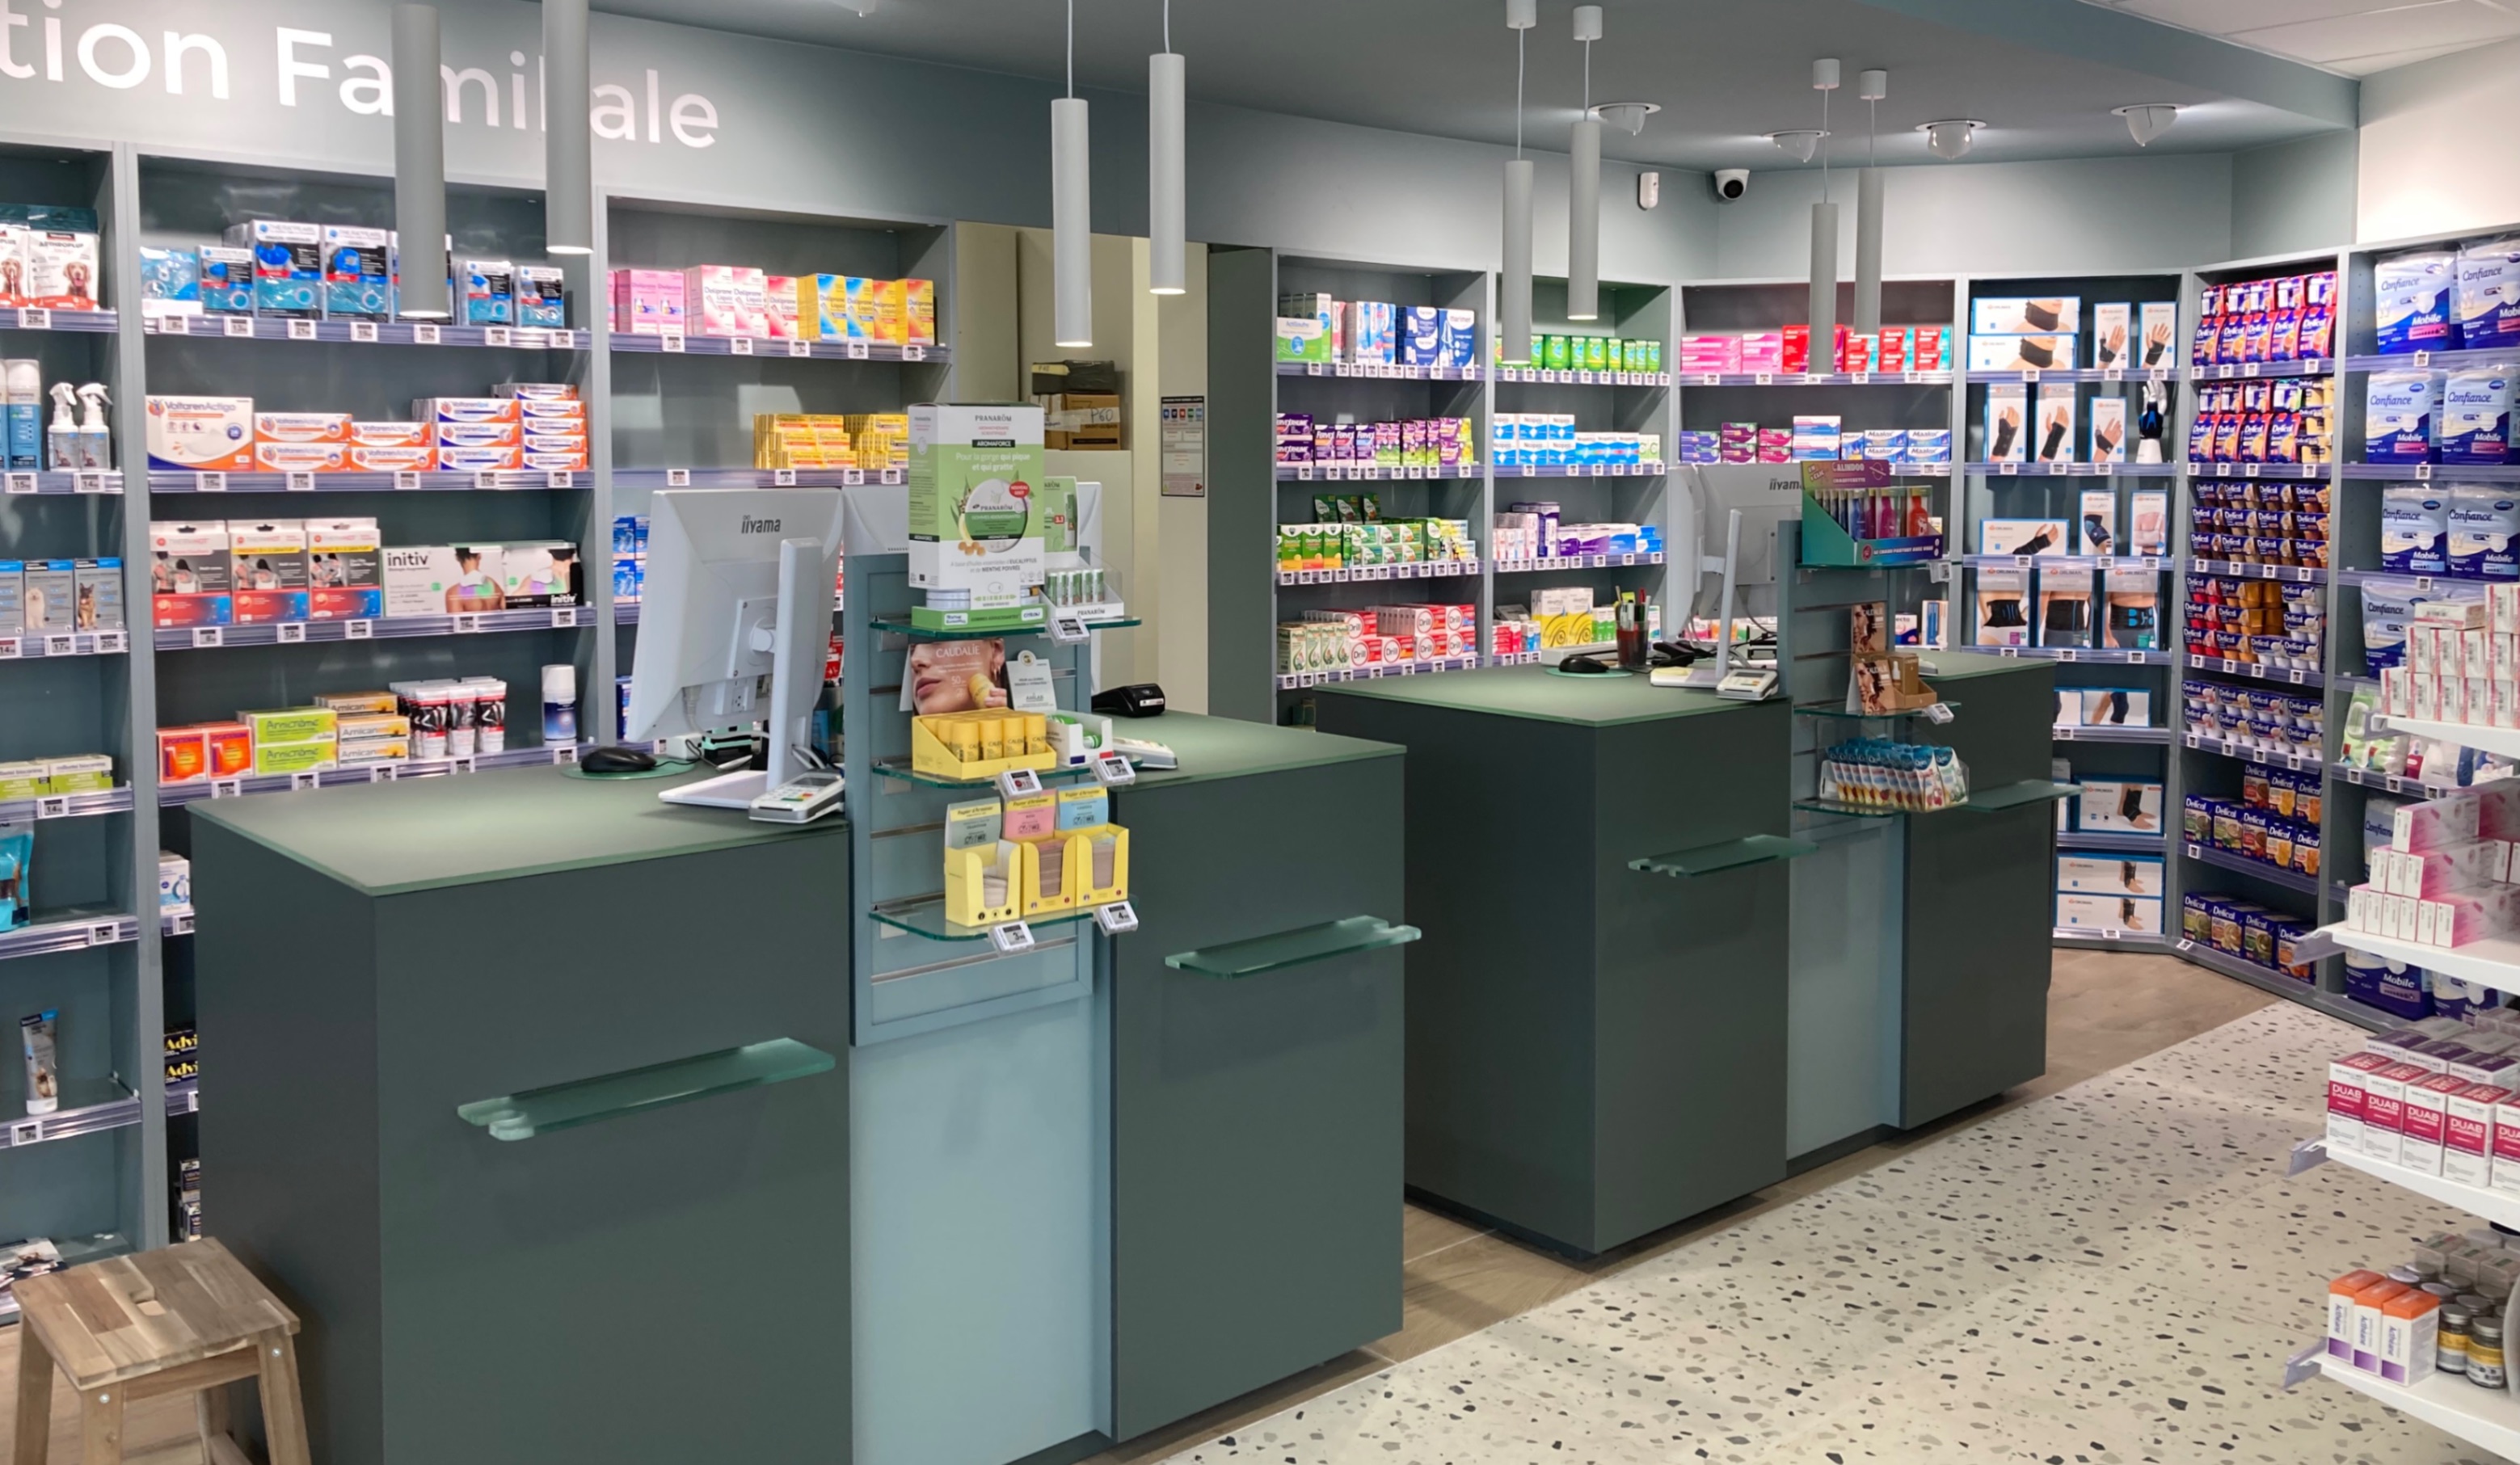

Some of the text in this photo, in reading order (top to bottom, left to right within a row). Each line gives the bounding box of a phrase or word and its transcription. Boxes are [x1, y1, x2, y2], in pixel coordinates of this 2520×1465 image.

[277, 27, 718, 149] Familale
[2463, 267, 2502, 282] Confiance
[2500, 306, 2520, 318] Mobi
[2412, 314, 2442, 325] Mobile
[2370, 395, 2412, 407] Confiance
[2448, 392, 2492, 403] Confiance
[2397, 434, 2423, 442] Mobile
[2475, 433, 2501, 442] Mobile
[1001, 453, 1011, 462] qui
[1012, 453, 1030, 462] pique
[980, 463, 992, 472] qui
[2383, 509, 2421, 522] Confiance
[2449, 509, 2493, 523] Confiance
[742, 516, 781, 534] iiyama
[387, 552, 429, 567] initiv
[2413, 551, 2439, 560] Mobile
[2485, 554, 2513, 563] Mobile
[550, 593, 576, 604] initiv
[2368, 603, 2404, 615] Confiance
[1418, 618, 1431, 626] Drill
[1449, 614, 1460, 622] Drill
[1386, 647, 1398, 655] Drill
[1420, 645, 1432, 653] Drill
[1448, 641, 1460, 650] Drill
[1354, 650, 1366, 658] Drill
[2219, 689, 2236, 700] Delical
[2185, 709, 2202, 718] Delical
[2252, 722, 2270, 732] Delical
[2272, 777, 2294, 789] Delical
[2186, 798, 2207, 810] Delical
[2269, 827, 2290, 840] Delical
[2365, 821, 2393, 838] Confian
[2185, 896, 2206, 910] Delical
[2246, 915, 2268, 928] Delical
[2383, 974, 2415, 988] Mobile
[166, 1034, 197, 1050] Advi
[166, 1061, 198, 1076] Advi
[2332, 1084, 2362, 1099] DUAB
[2369, 1096, 2400, 1112] DUAB
[2408, 1107, 2440, 1122] DUAB
[2450, 1119, 2483, 1134] DUAB
[2498, 1126, 2520, 1139] DUA
